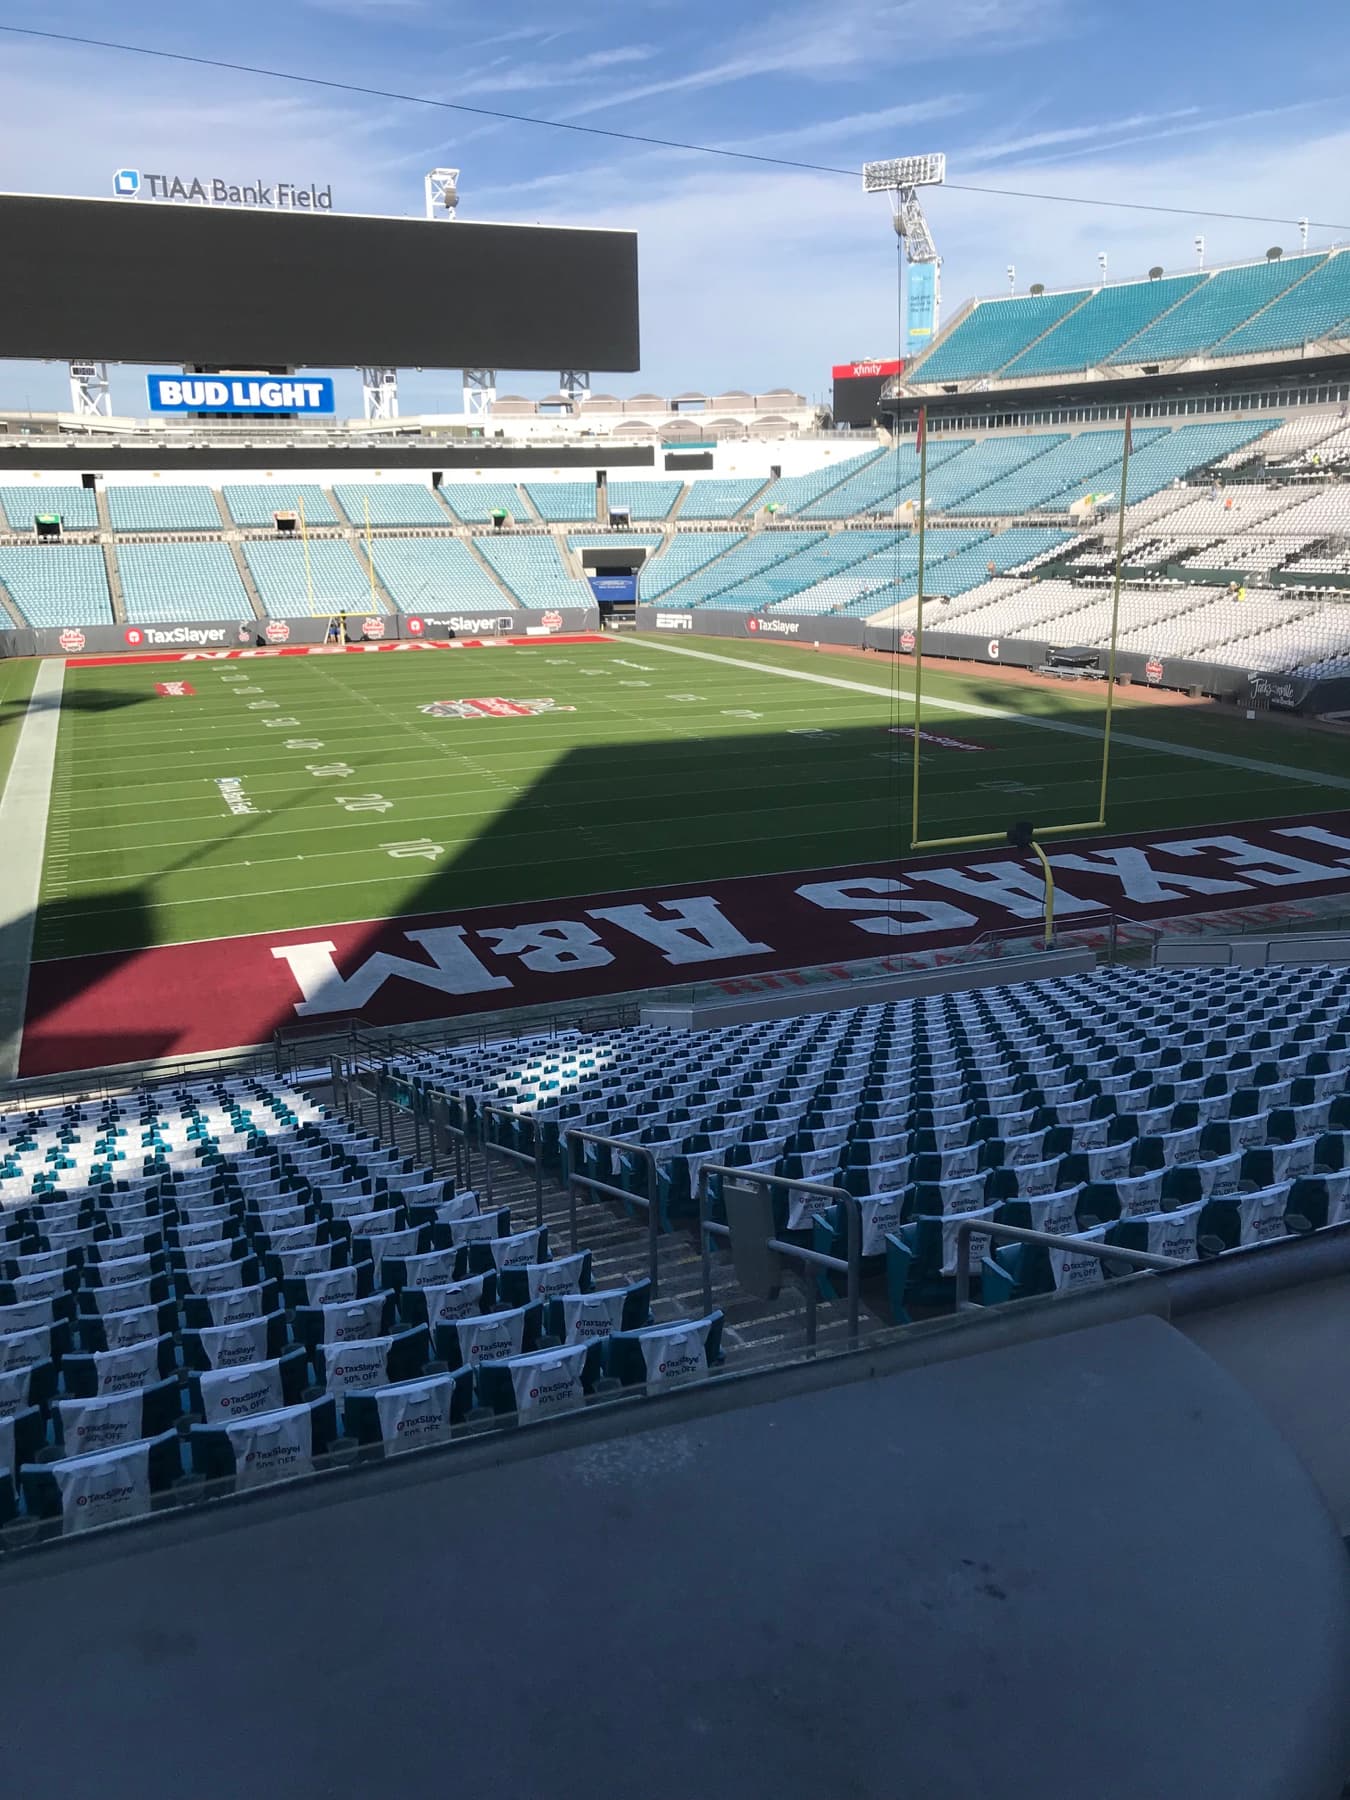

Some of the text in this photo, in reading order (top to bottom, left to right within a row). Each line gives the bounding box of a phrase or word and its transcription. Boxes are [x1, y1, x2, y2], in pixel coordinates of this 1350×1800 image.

[144, 174, 332, 209] TIAA Bank Field
[853, 363, 882, 376] xfinity
[159, 381, 323, 408] BUD LIGHT
[656, 613, 693, 630] ESPN
[758, 618, 799, 634] TaxSlayer
[144, 627, 226, 645] TaxSlayer
[379, 838, 445, 858] 10
[480, 1340, 512, 1350] TaxSlaye
[344, 1371, 378, 1385] 50% OFF
[556, 1391, 572, 1400] OFF
[231, 1398, 266, 1415] 50% OFF
[405, 1415, 442, 1428] TaxSlaye
